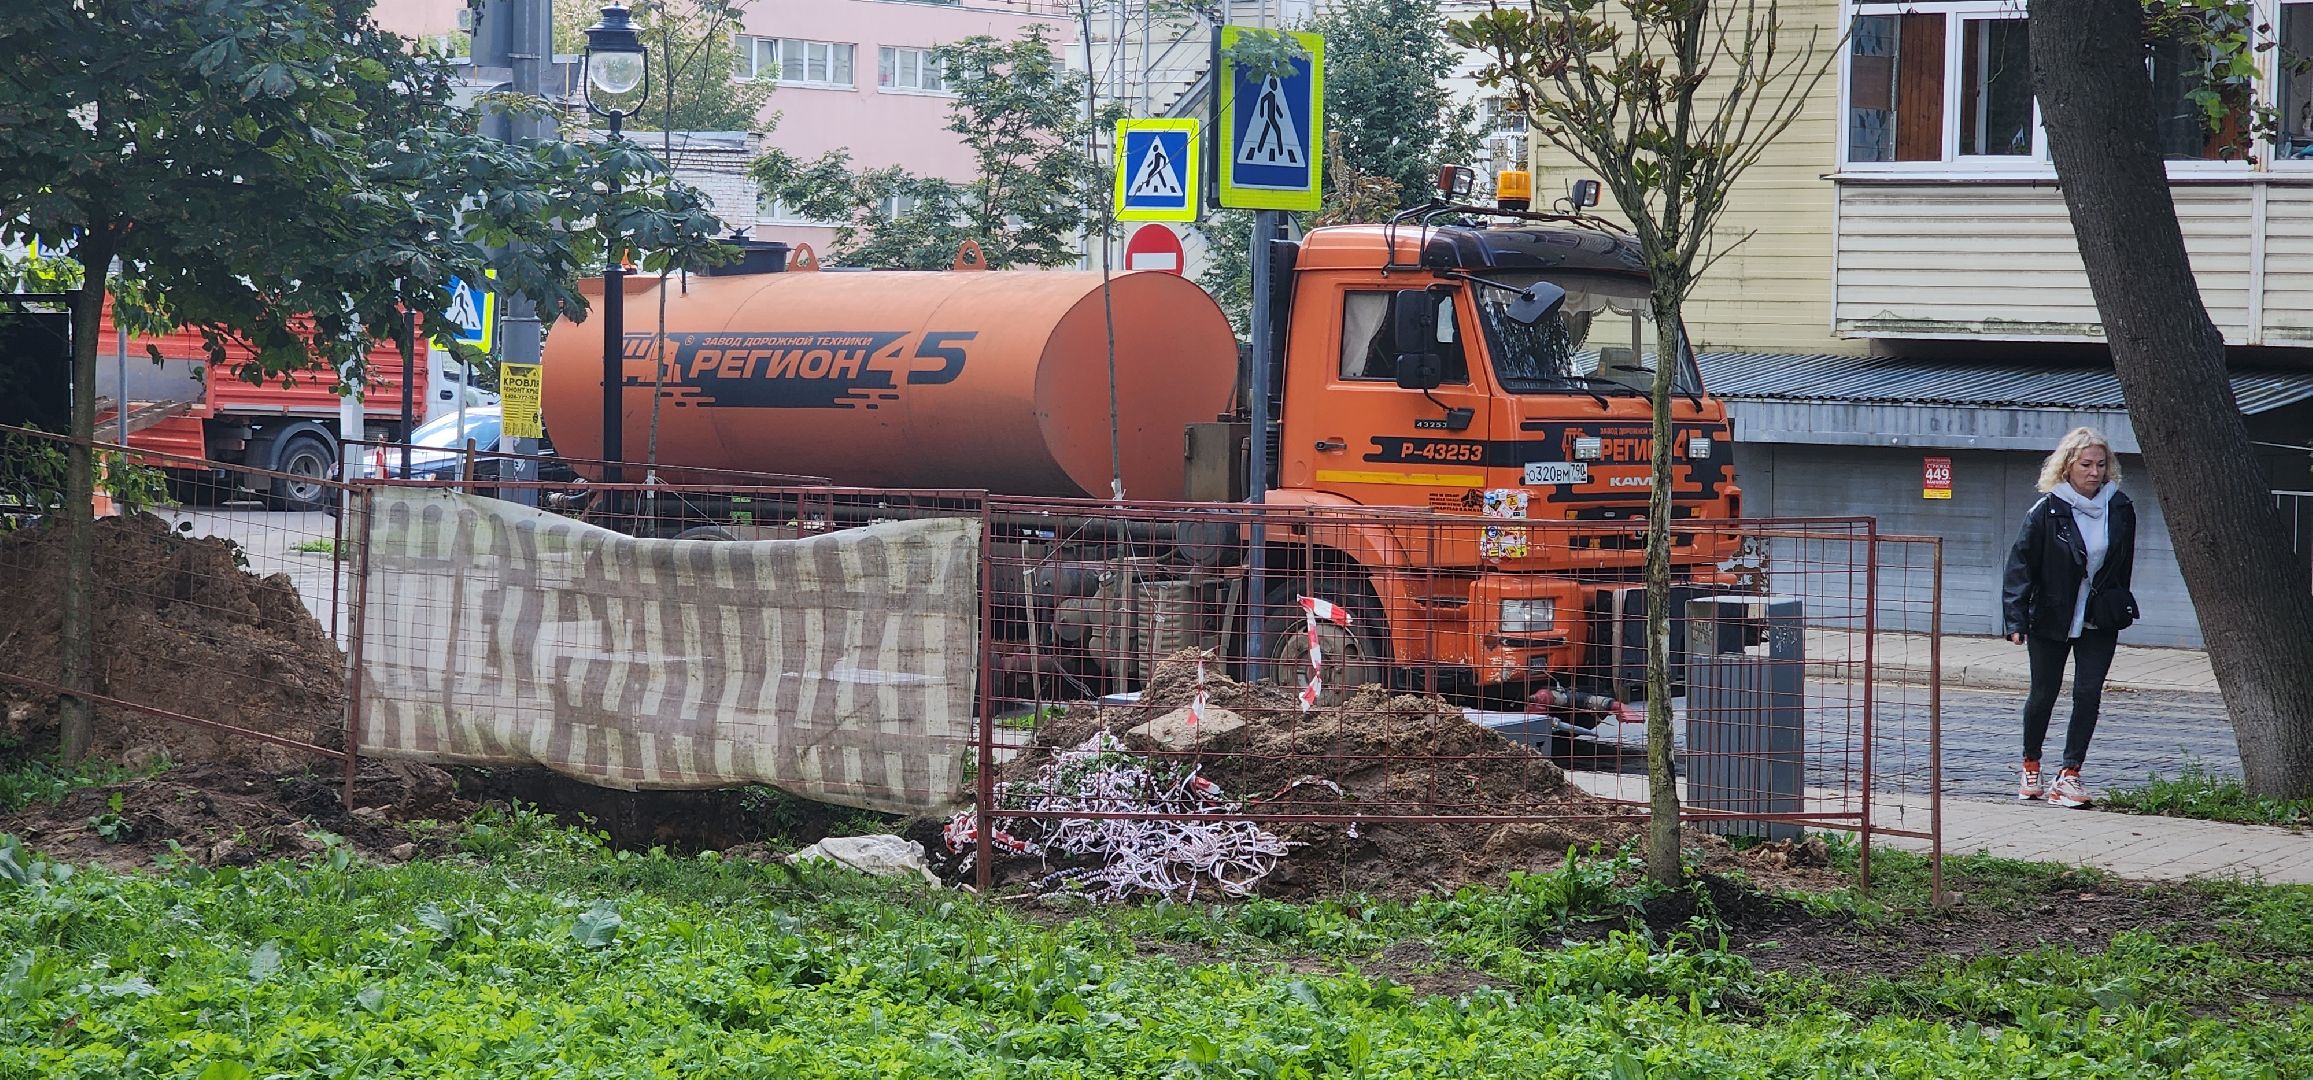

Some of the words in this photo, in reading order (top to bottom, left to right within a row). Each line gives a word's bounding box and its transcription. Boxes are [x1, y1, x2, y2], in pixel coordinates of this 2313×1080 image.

[703, 337, 741, 347] ЗАВОД
[744, 335, 813, 347] ДОРОЖНОЙ
[816, 337, 873, 346] ТЕХНИКИ
[688, 349, 867, 379] РЕГИОН
[866, 331, 979, 385] 45
[1401, 442, 1483, 460] Р-43253
[1571, 463, 1585, 476] 790
